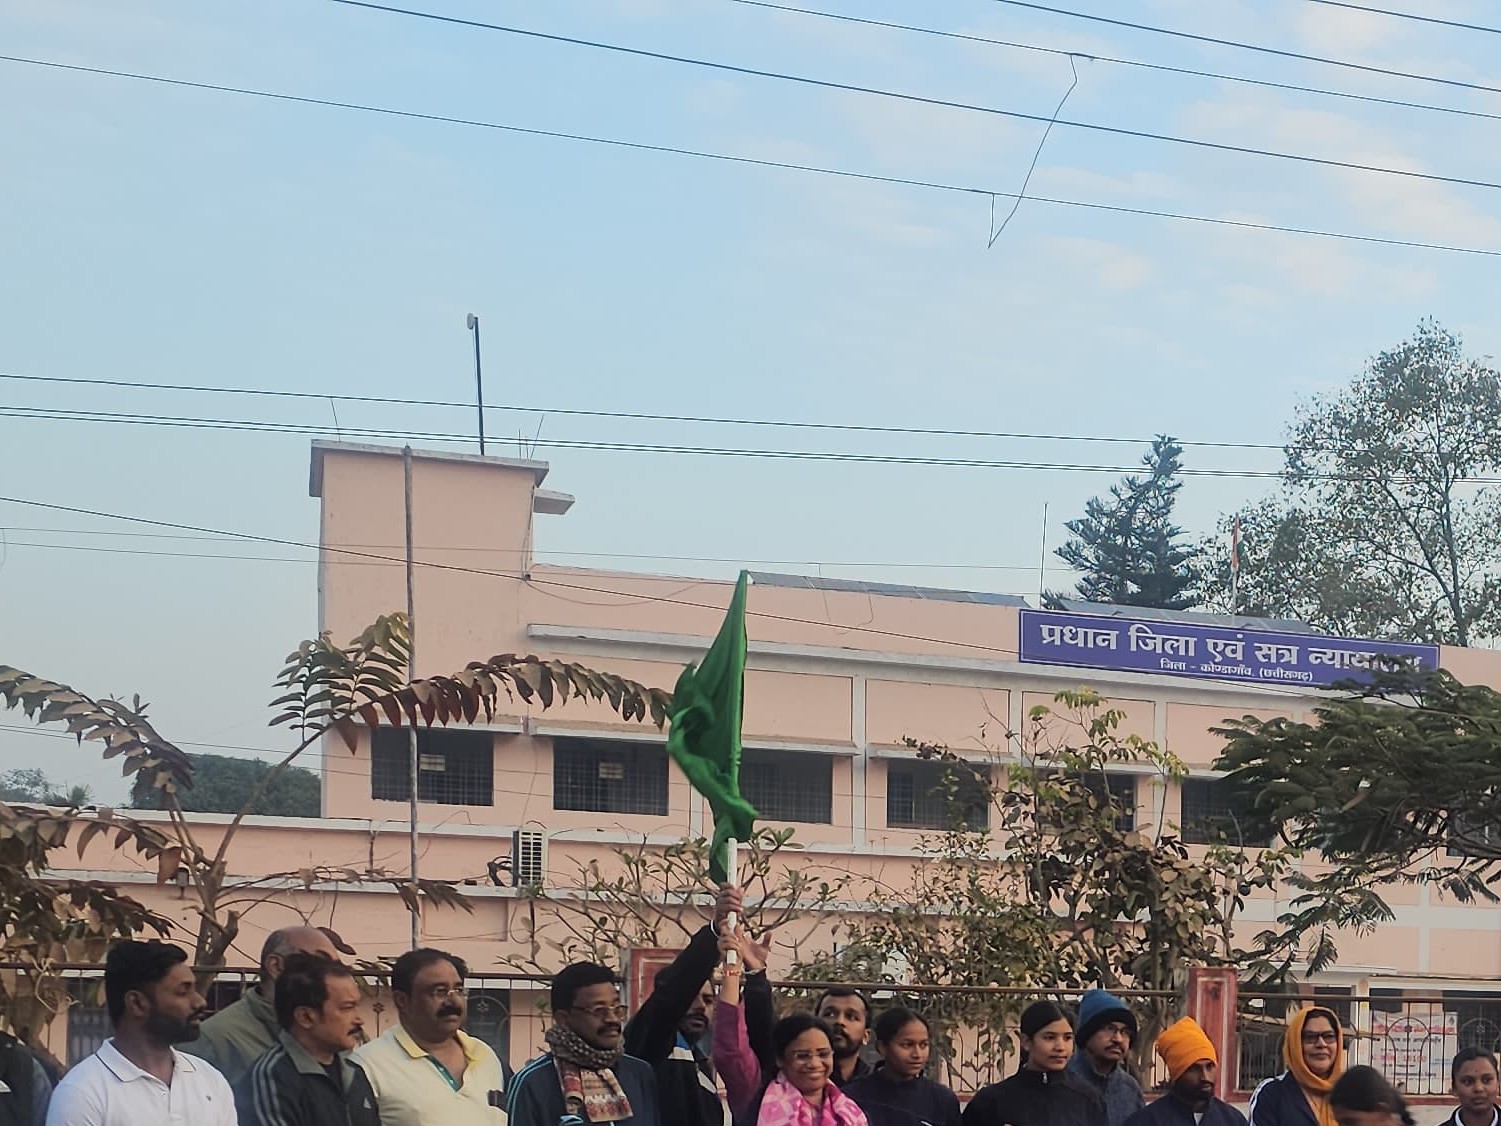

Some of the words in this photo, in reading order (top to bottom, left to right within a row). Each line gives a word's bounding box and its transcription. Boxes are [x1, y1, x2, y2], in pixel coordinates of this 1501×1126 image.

[1040, 624, 1119, 650] प्रधान
[1128, 624, 1197, 656] जिला
[1206, 633, 1245, 662] एवं
[1254, 643, 1299, 665] सत्र
[1160, 657, 1186, 670] जिला
